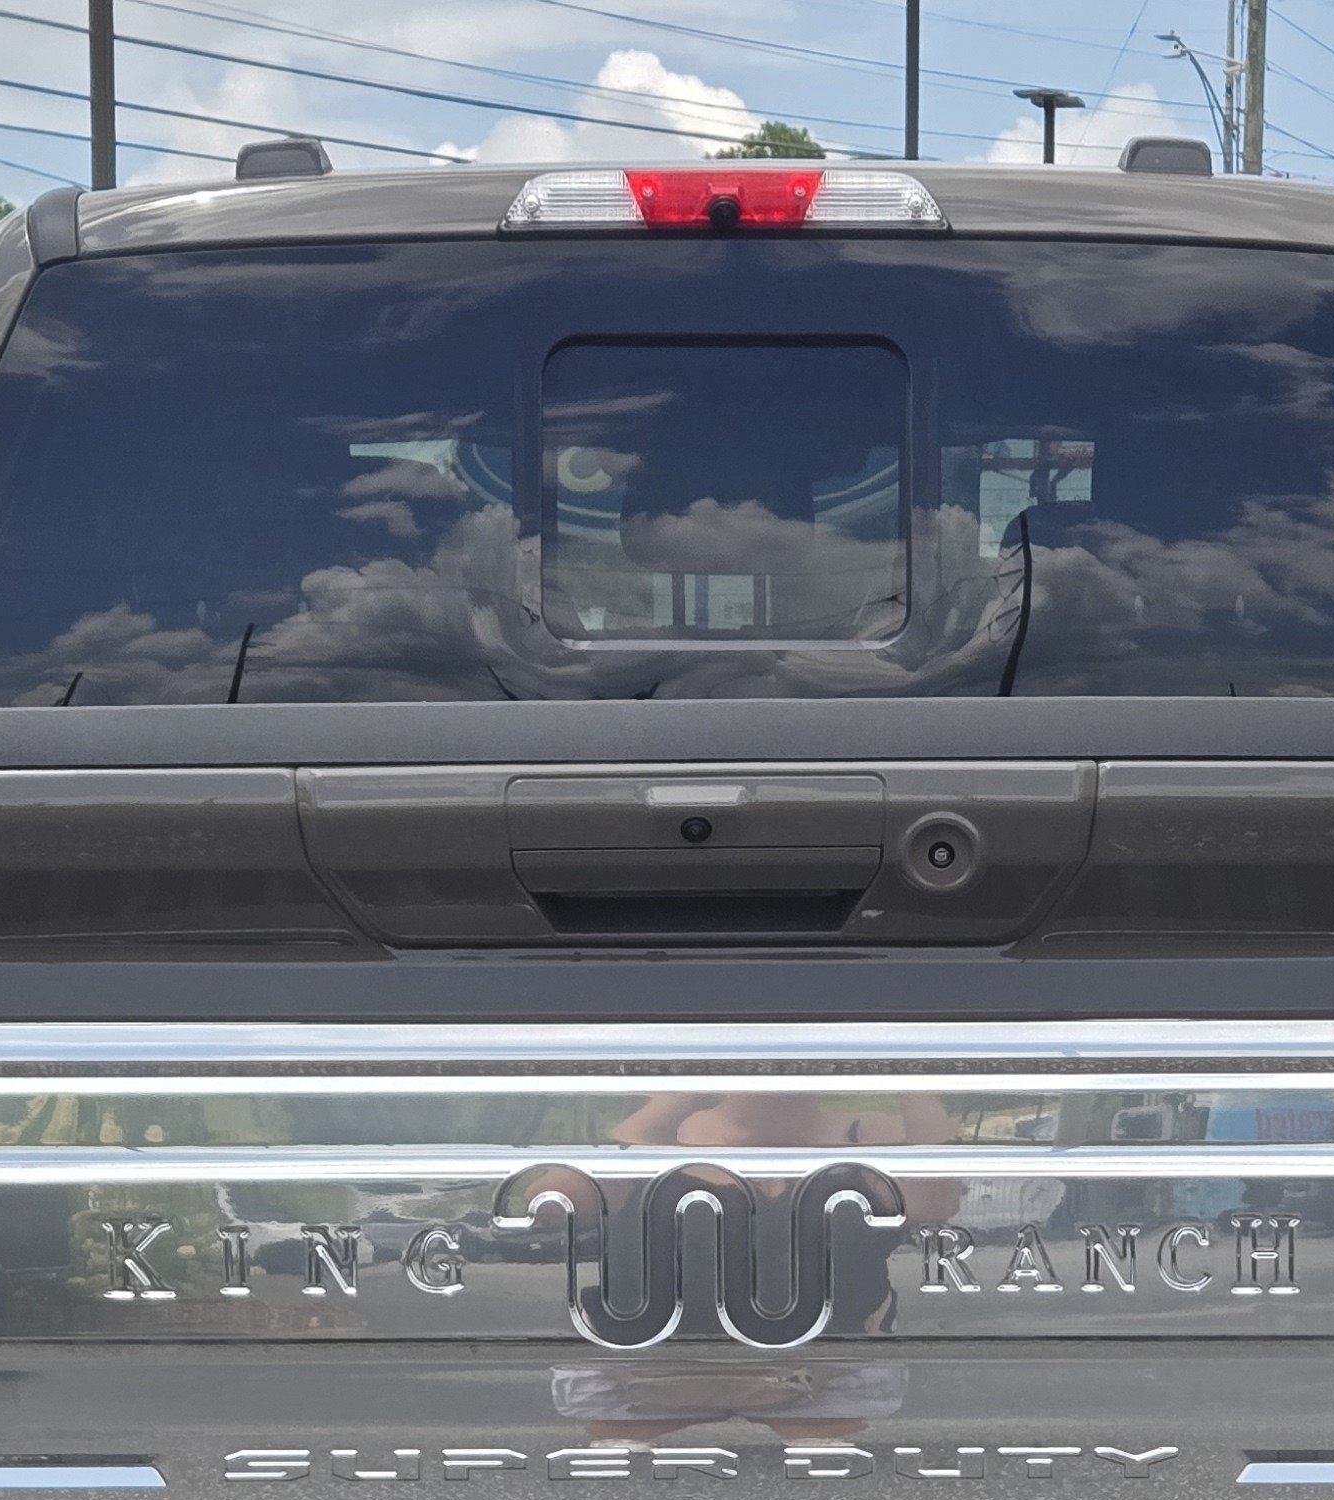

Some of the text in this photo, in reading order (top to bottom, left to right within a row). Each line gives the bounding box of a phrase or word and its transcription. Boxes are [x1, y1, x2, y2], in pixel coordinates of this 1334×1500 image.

[102, 1212, 1302, 1300] KING RANCH
[224, 1446, 1180, 1481] SUPER DUTY
